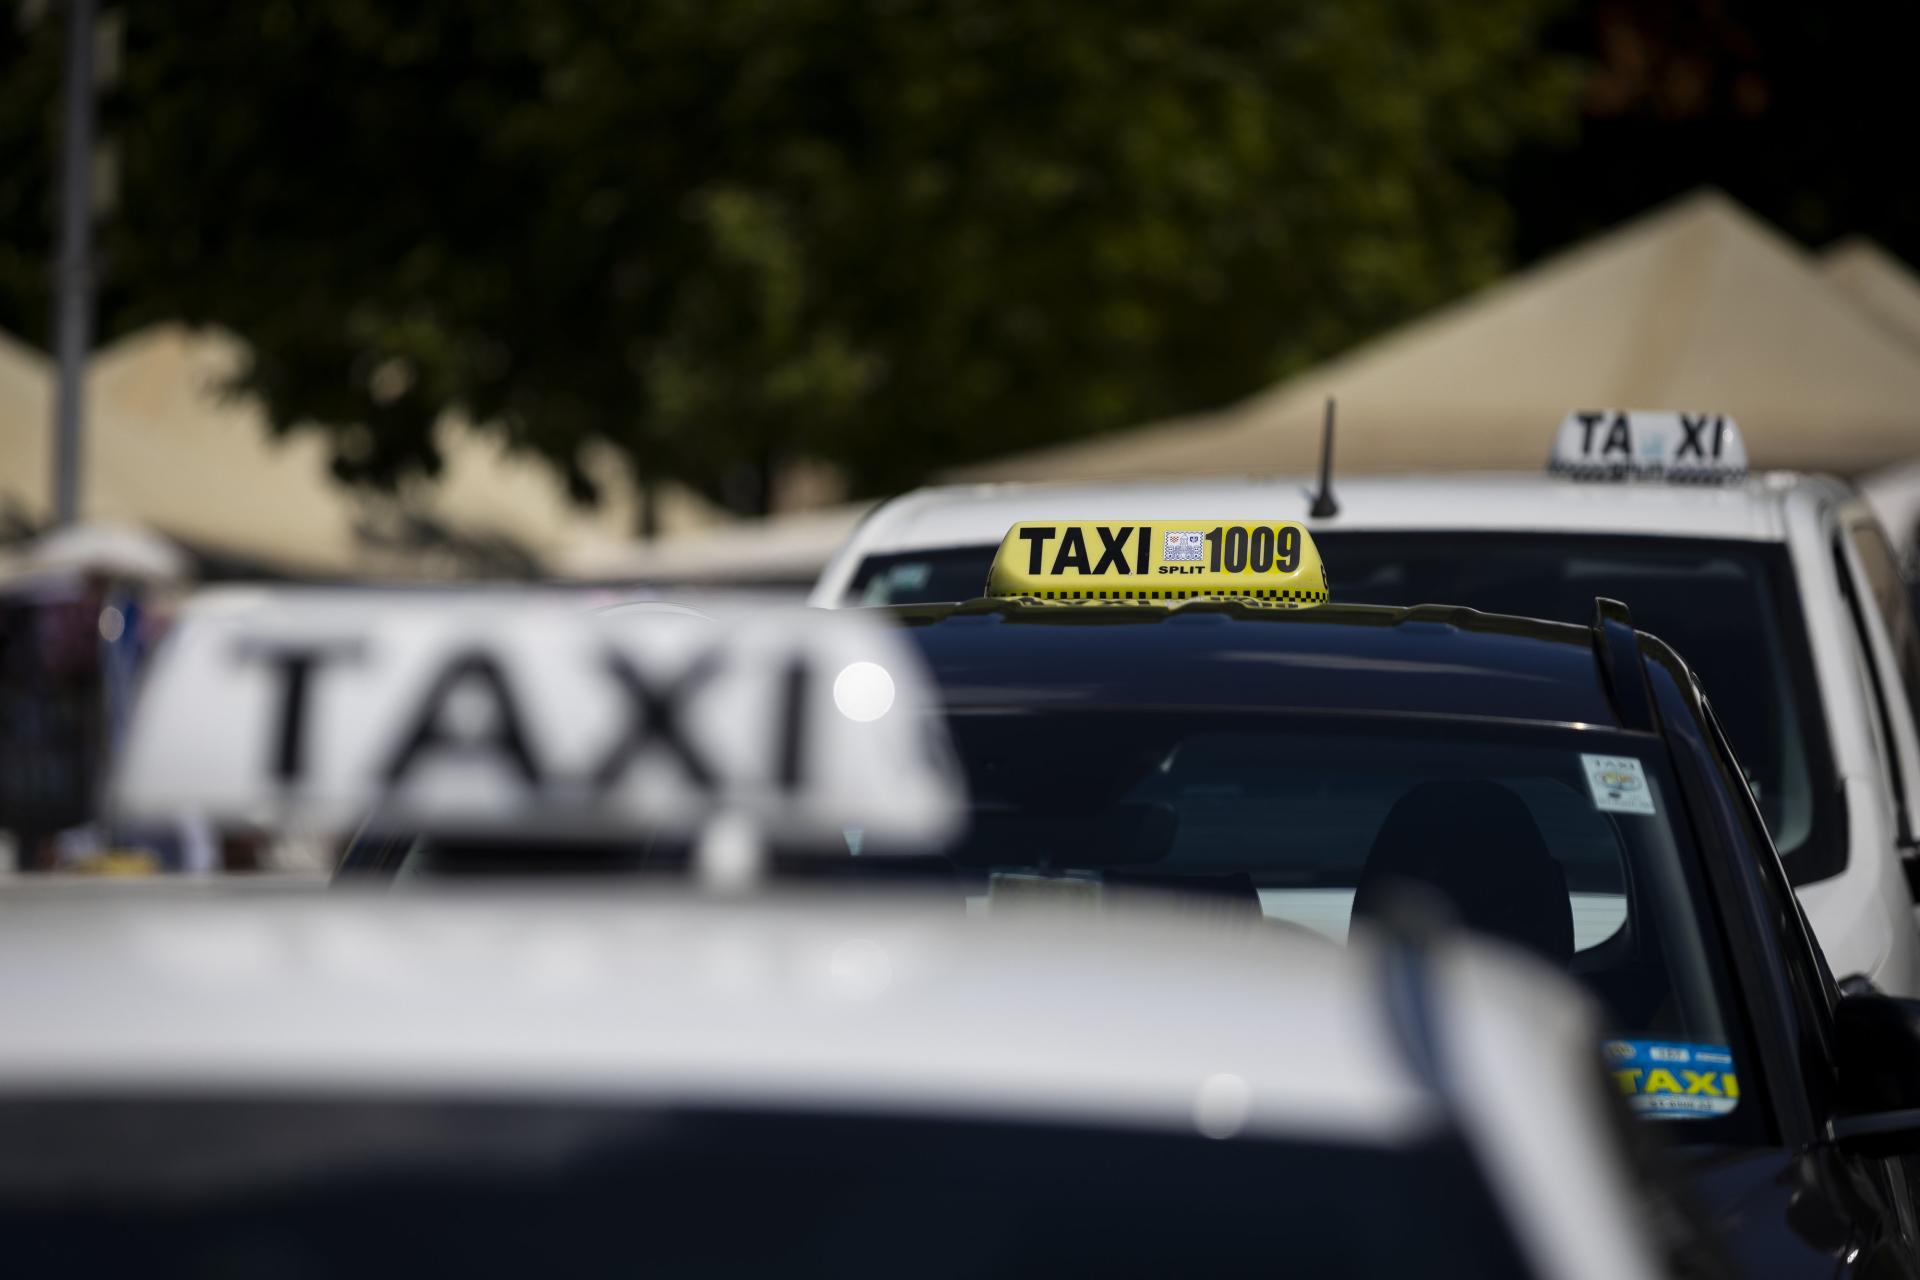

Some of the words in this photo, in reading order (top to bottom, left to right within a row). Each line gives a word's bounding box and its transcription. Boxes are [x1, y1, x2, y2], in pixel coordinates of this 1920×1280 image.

[1019, 526, 1152, 575] TAXI
[1205, 526, 1301, 573] 1009
[1158, 565, 1206, 575] SPLIT
[230, 637, 814, 788] TAXI
[1613, 1067, 1739, 1098] TAXI
